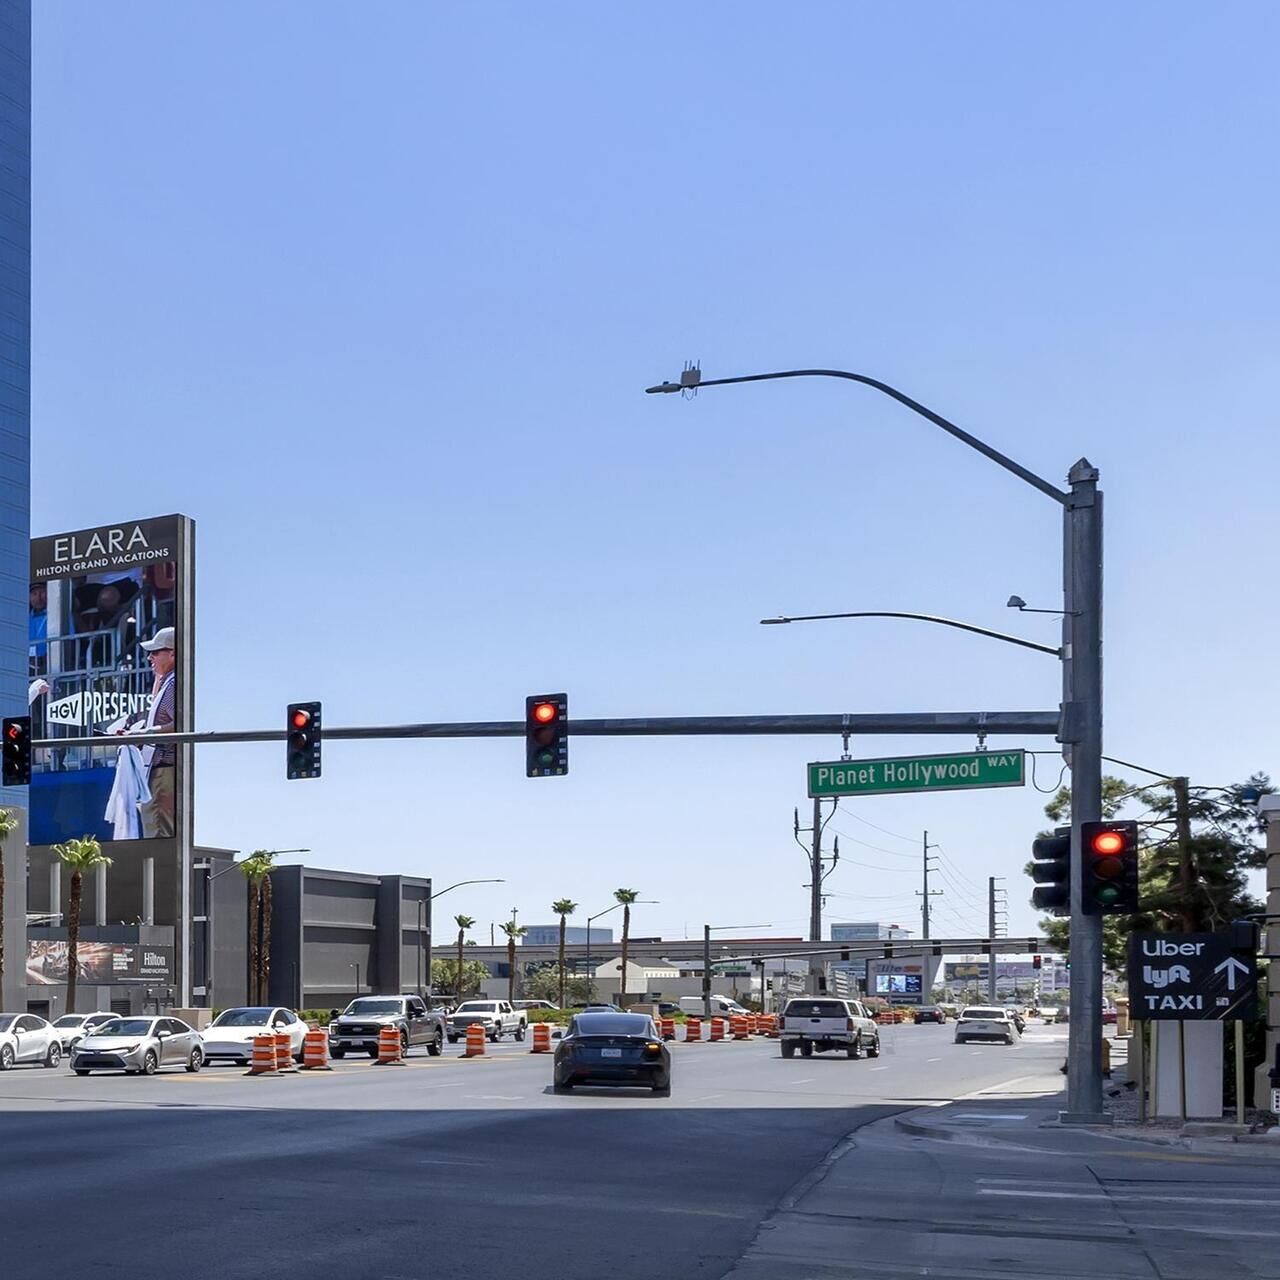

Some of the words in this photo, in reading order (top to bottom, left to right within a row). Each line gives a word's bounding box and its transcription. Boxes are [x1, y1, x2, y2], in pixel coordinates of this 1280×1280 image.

[54, 525, 149, 563] ELARA
[36, 564, 71, 577] HILTON
[72, 557, 109, 571] GRAND
[111, 548, 169, 564] VACATIONS
[49, 700, 79, 719] HGV
[84, 691, 155, 726] PRESENTS
[818, 765, 876, 786] Planet
[884, 758, 980, 785] Hollywood
[987, 755, 1018, 767] WAY
[143, 952, 166, 966] Hilton
[1142, 939, 1206, 957] Uber
[1143, 964, 1191, 989] lyft
[1143, 995, 1203, 1010] TAXI
